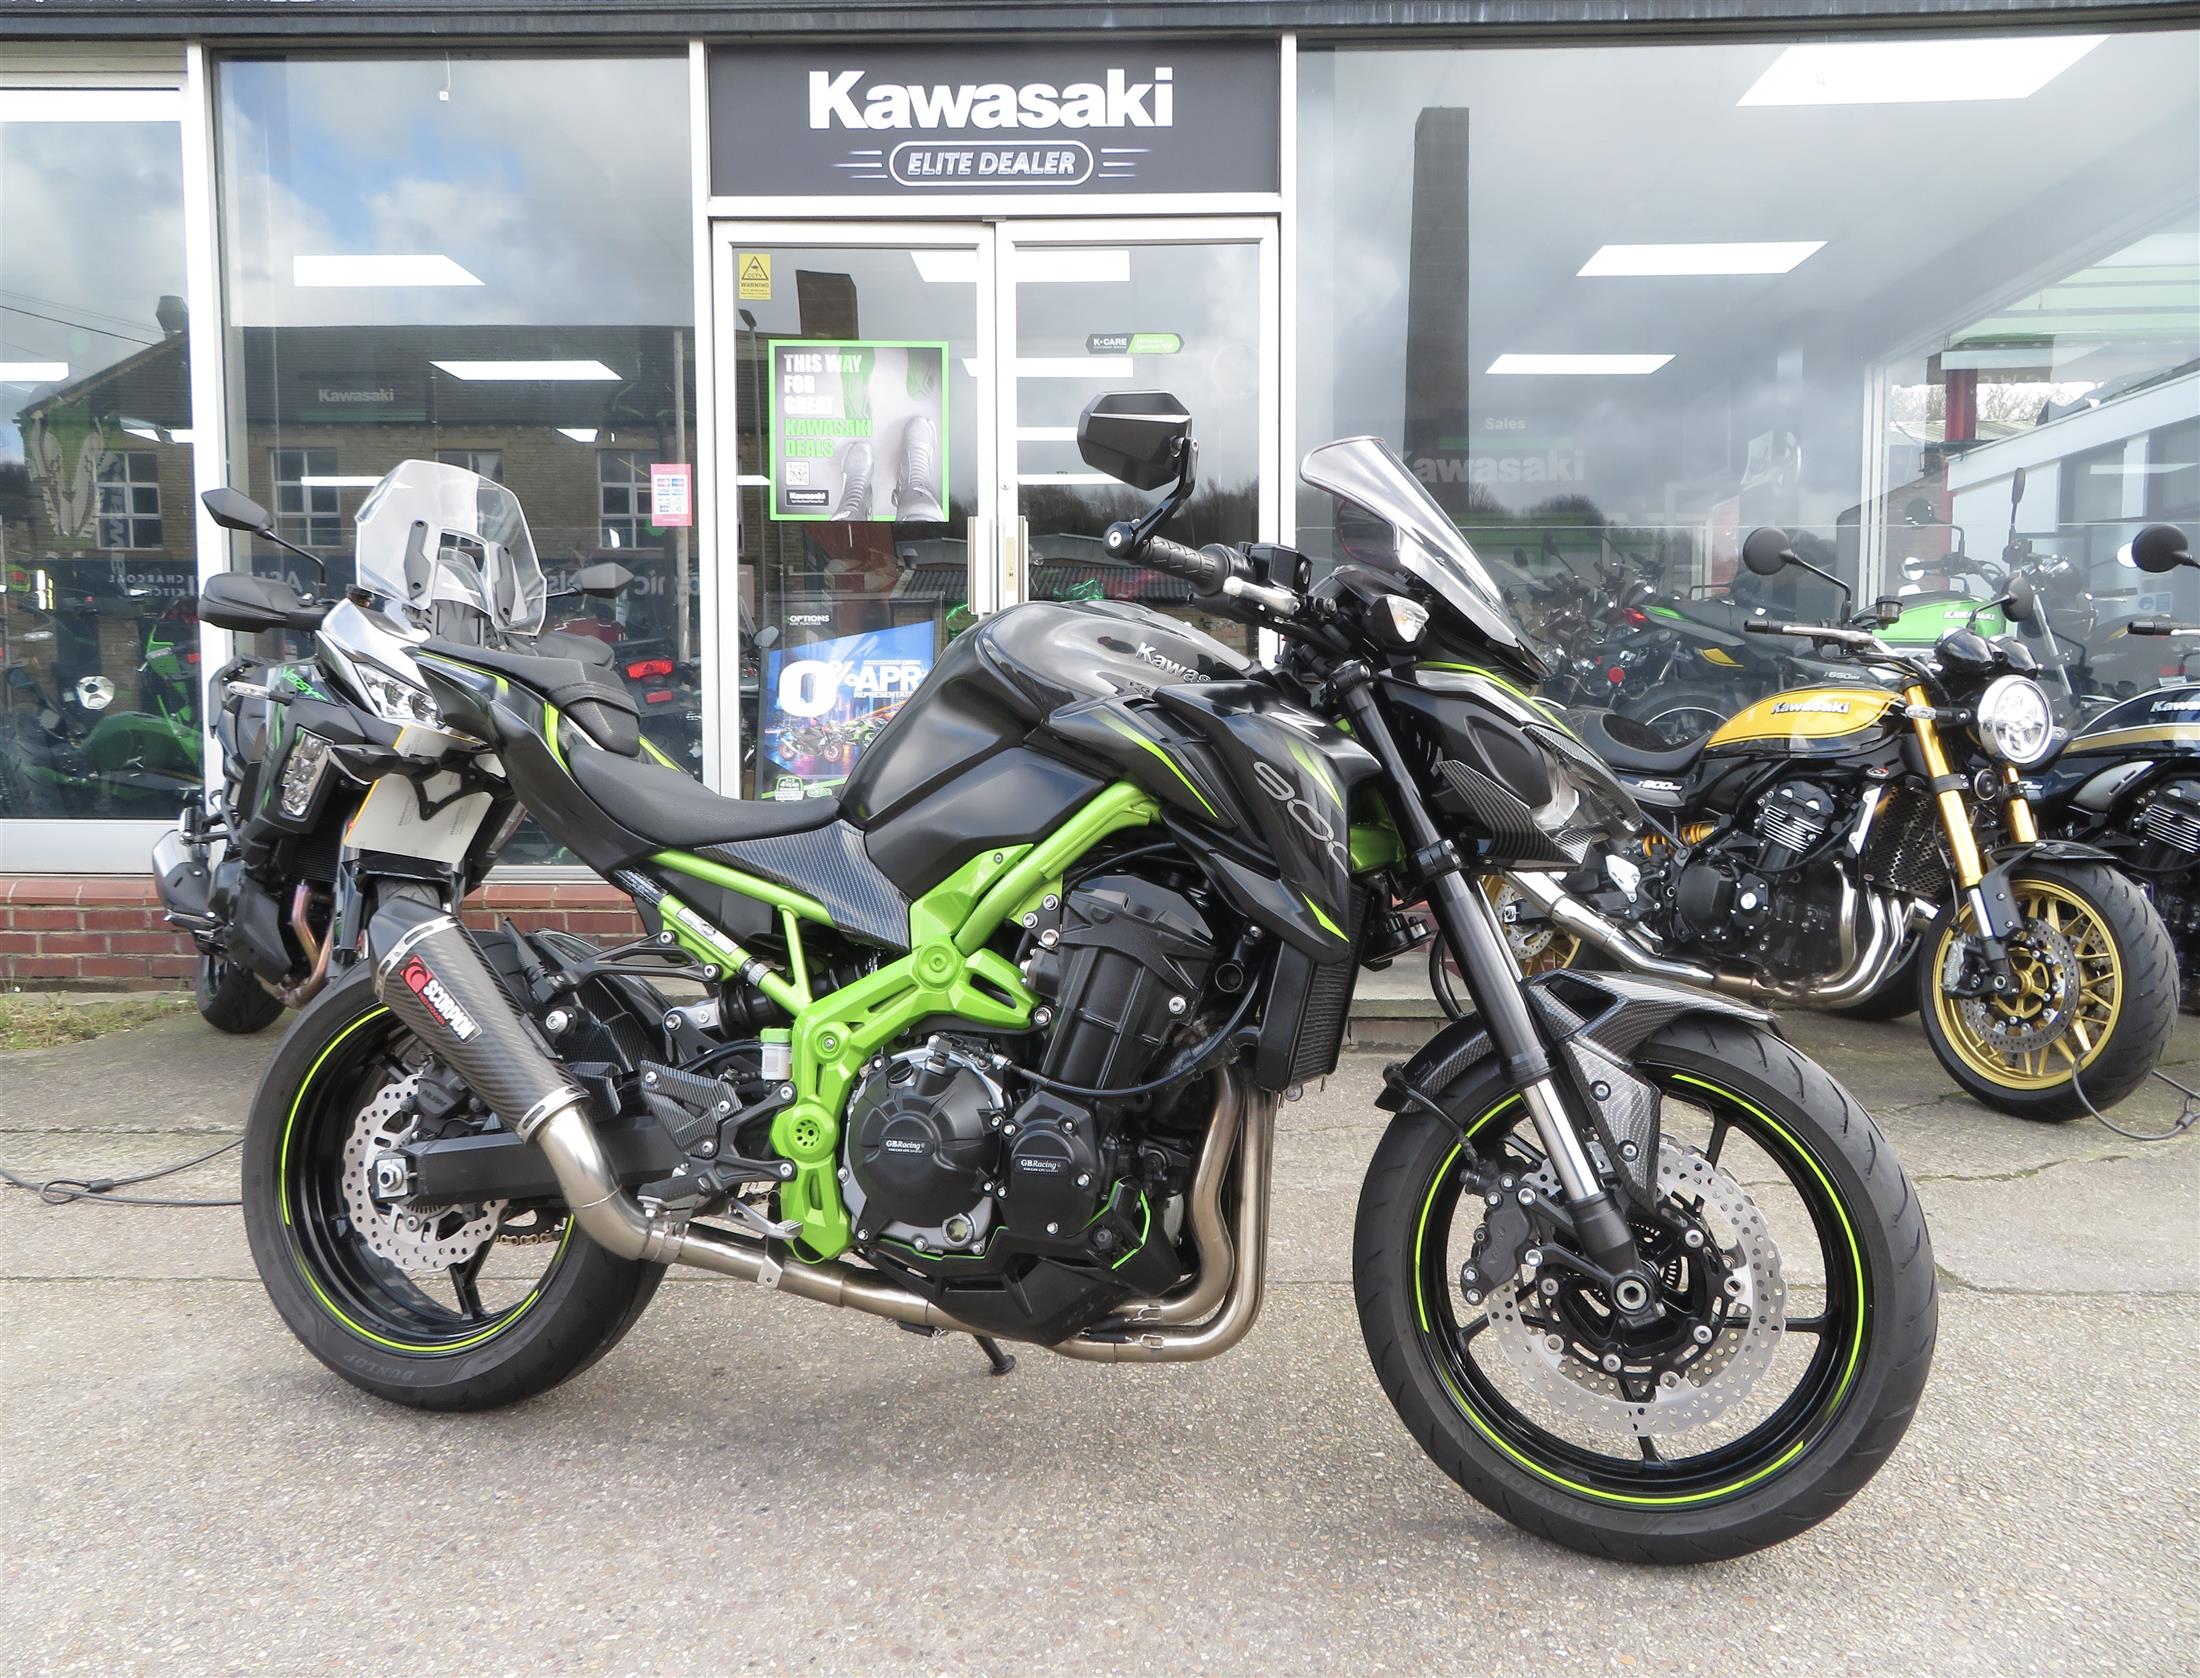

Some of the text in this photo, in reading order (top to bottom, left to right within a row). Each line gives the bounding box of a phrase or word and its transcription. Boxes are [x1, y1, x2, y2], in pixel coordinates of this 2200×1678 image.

[809, 67, 1173, 129] Kawasaki
[907, 152, 1075, 175] ELITE DEALER
[784, 354, 862, 373] THIS WAY
[783, 374, 816, 394] FOR
[319, 388, 394, 402] Kawasaki
[784, 417, 873, 437] KAWASAKI
[1485, 418, 1526, 430] Sales
[784, 438, 834, 457] DEALS
[1771, 702, 1849, 714] Kawasaki
[423, 979, 475, 1040] SCORPION
[343, 1354, 416, 1381] DUNLOP
